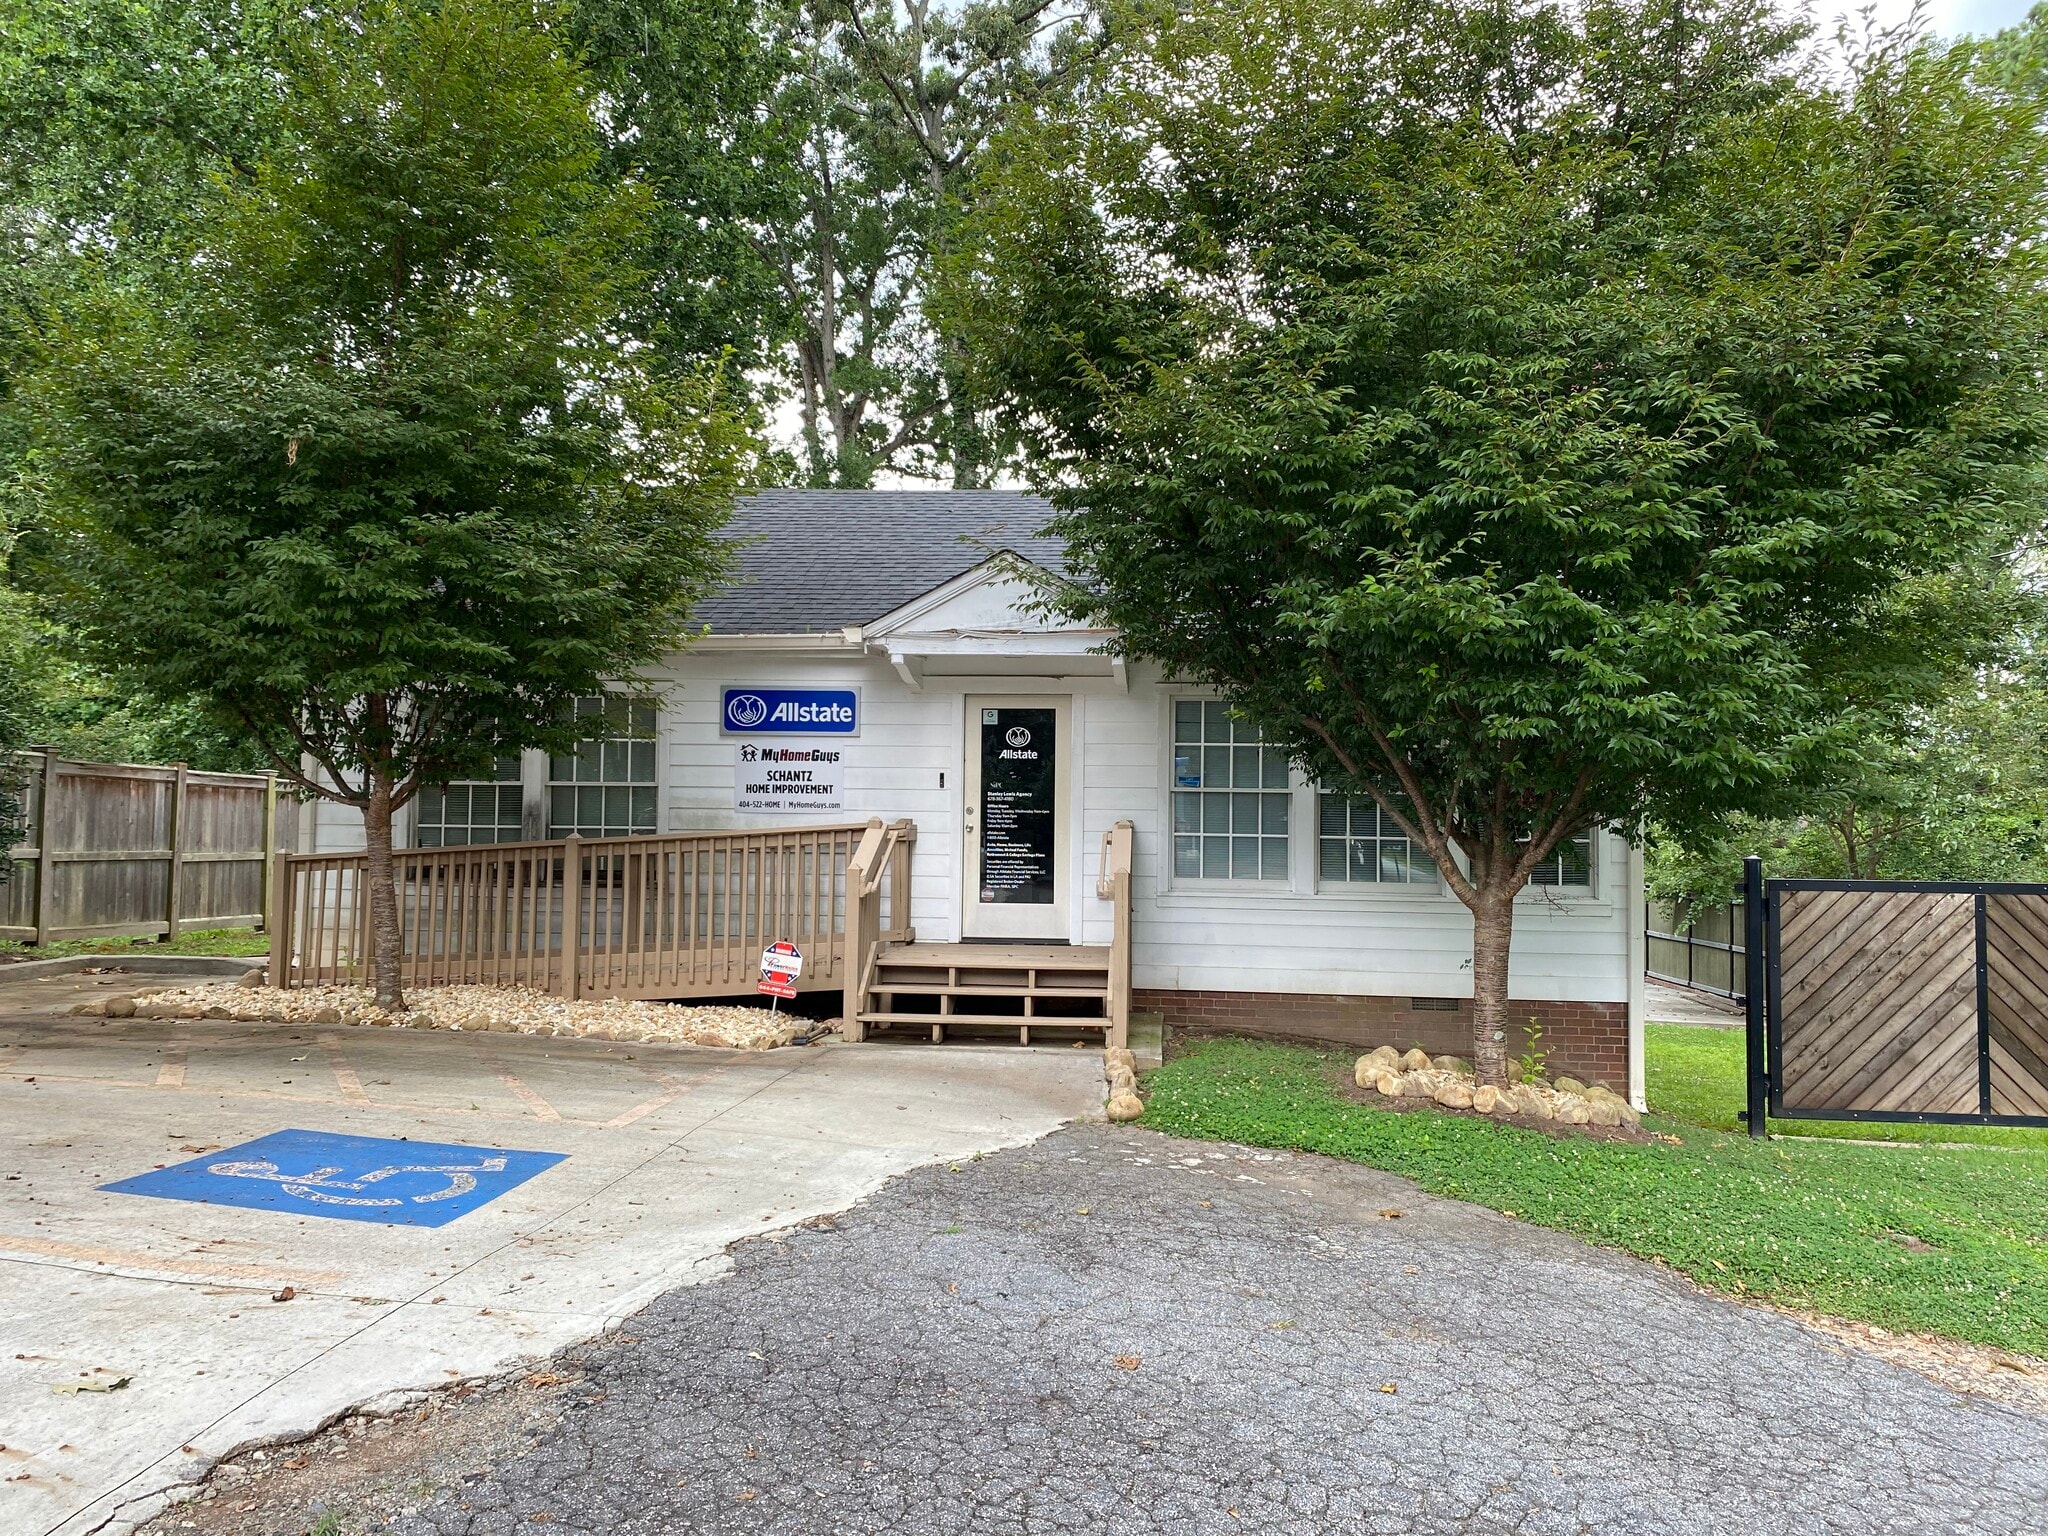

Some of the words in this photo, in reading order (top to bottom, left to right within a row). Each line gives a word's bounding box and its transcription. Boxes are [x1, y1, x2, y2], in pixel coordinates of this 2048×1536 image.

[770, 702, 852, 722] Allstate
[761, 749, 840, 763] MyHomeGuys
[999, 749, 1038, 759] Allstate
[767, 770, 812, 782] SCHANTZ
[746, 784, 770, 793] HOME
[772, 784, 833, 794] IMPROVEMENT
[788, 801, 840, 809] MyHomeGuys.com
